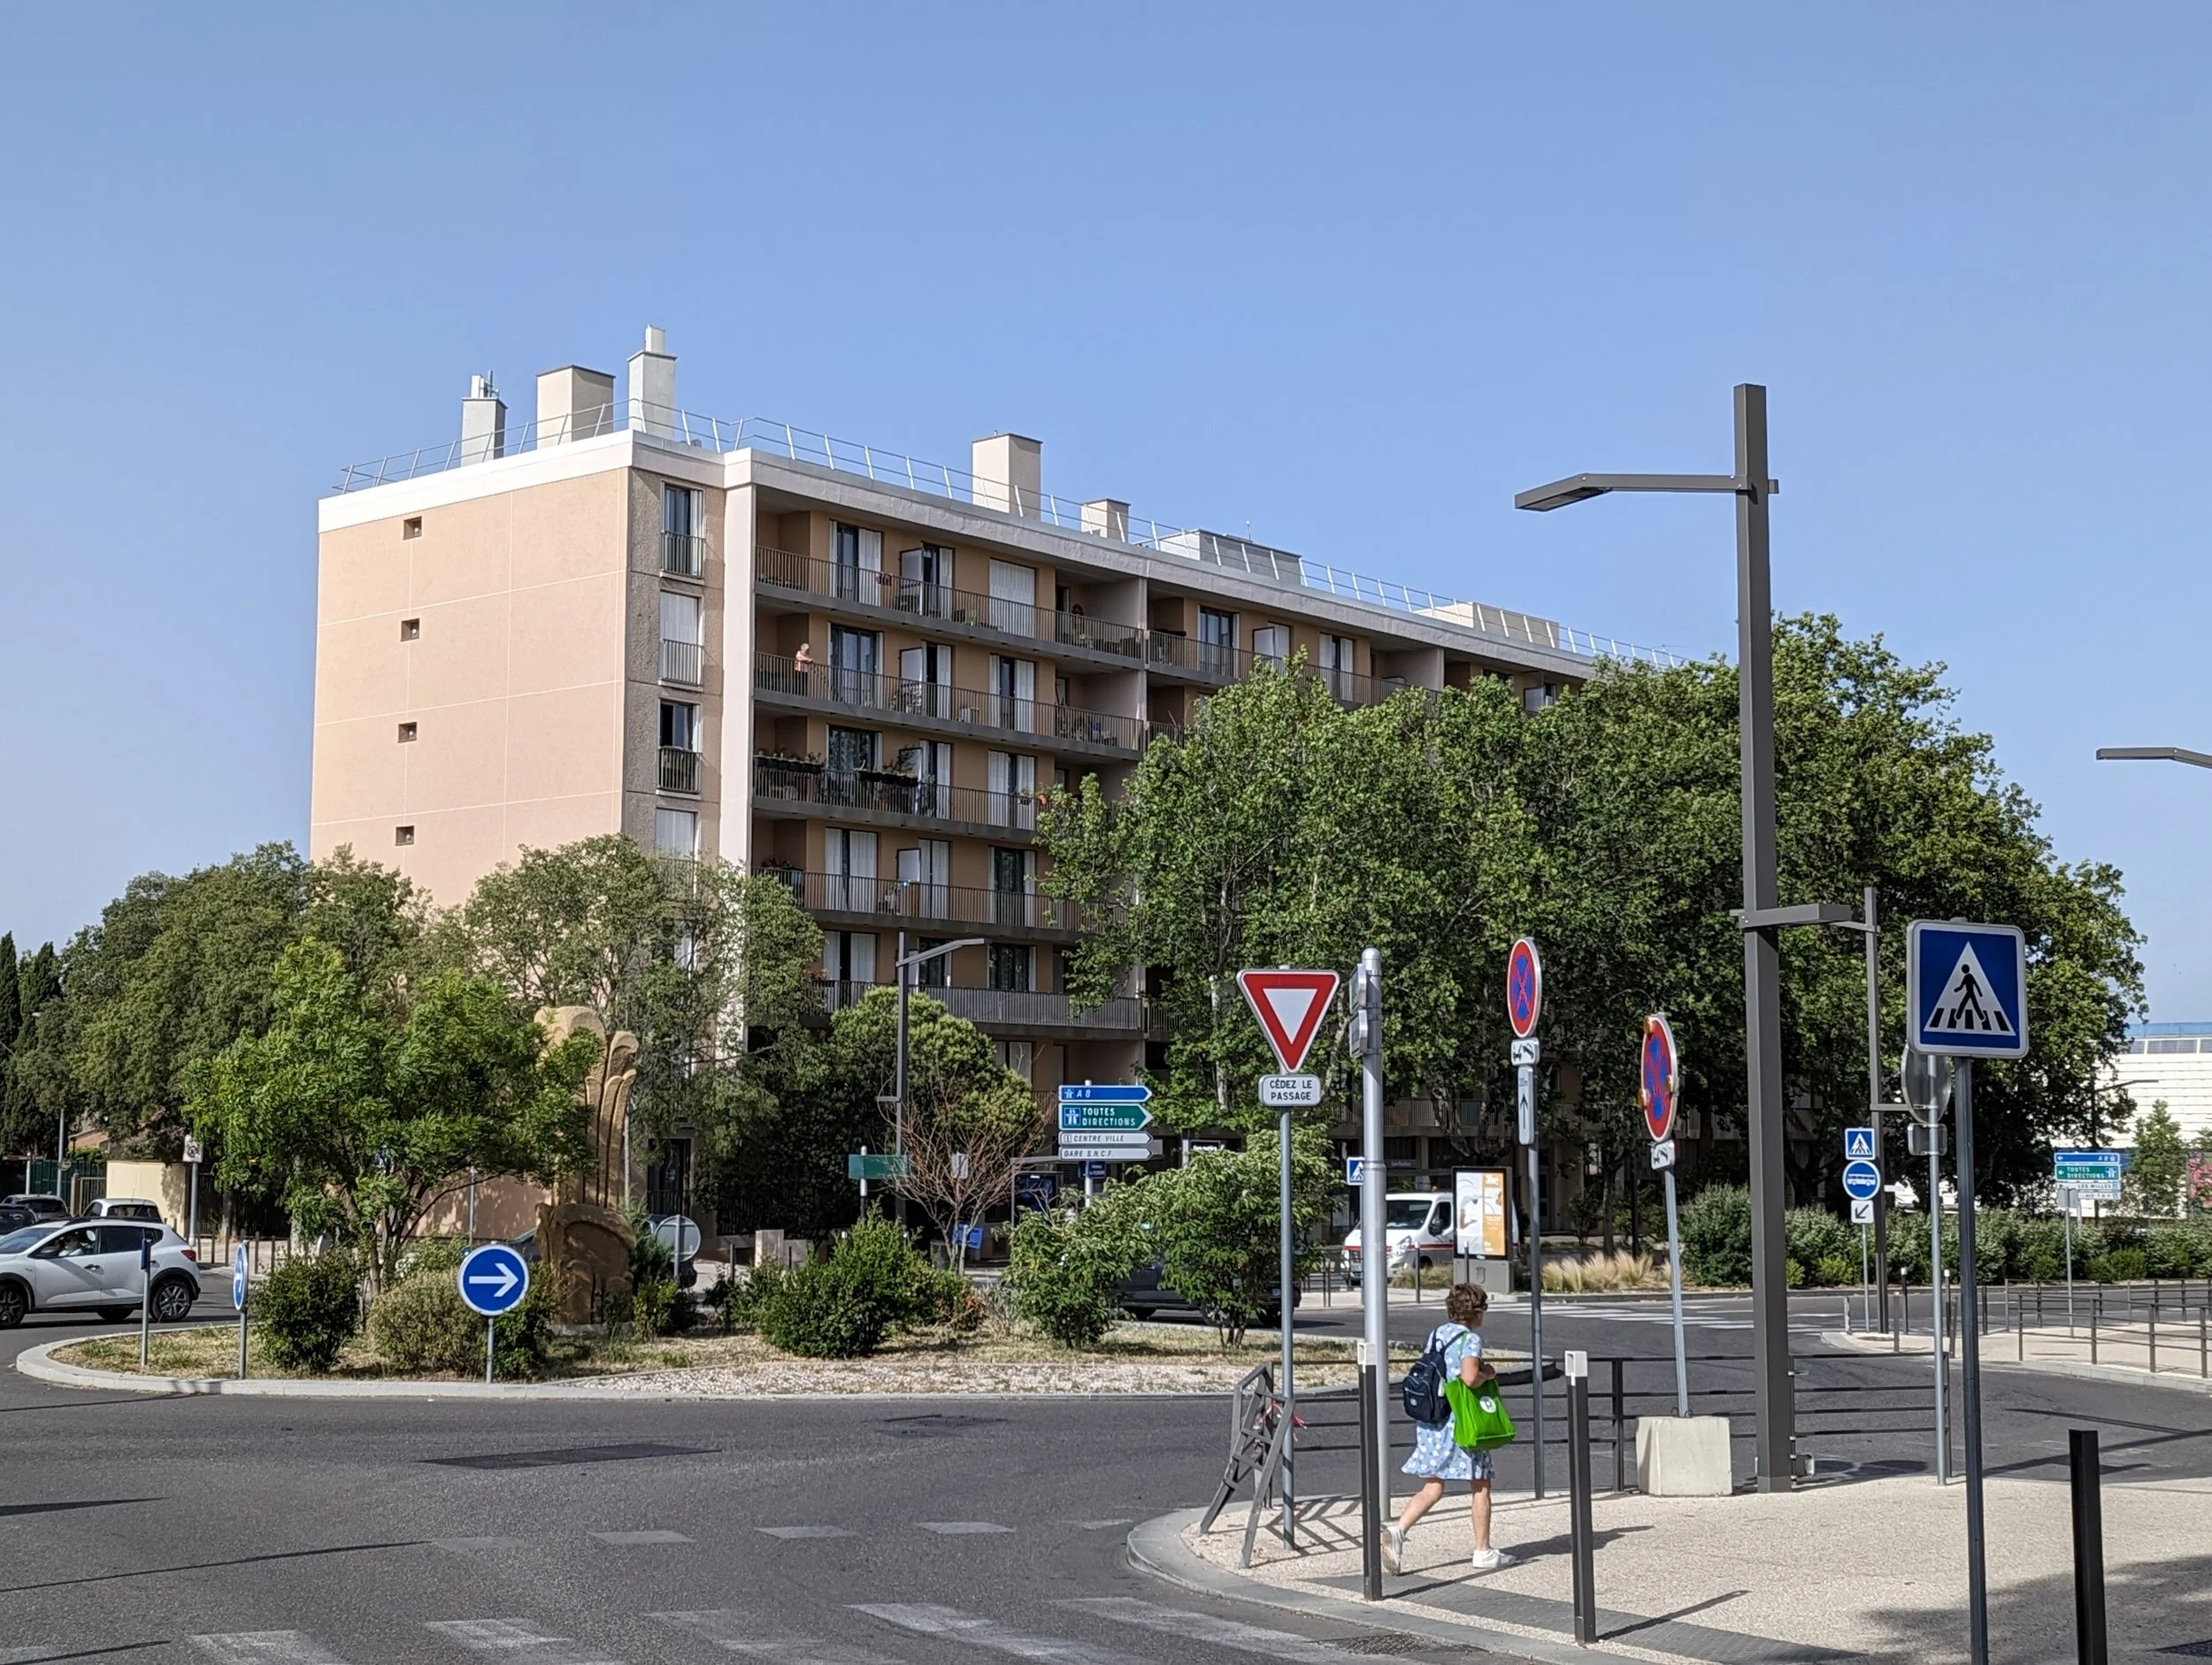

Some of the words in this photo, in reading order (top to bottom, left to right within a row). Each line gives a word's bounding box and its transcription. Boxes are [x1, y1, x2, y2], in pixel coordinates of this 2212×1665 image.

[1269, 1078, 1296, 1089] CÉDEZ
[1302, 1079, 1313, 1089] LE
[1076, 1089, 1083, 1098] A
[1085, 1089, 1092, 1099] 8
[1271, 1091, 1312, 1101] PASSAGE
[1082, 1107, 1116, 1116] TOUTES
[1082, 1117, 1136, 1126] DIRECTIONS
[1072, 1134, 1102, 1143] CENTRE
[1104, 1134, 1125, 1143] VILLE
[1064, 1149, 1084, 1158] GARE
